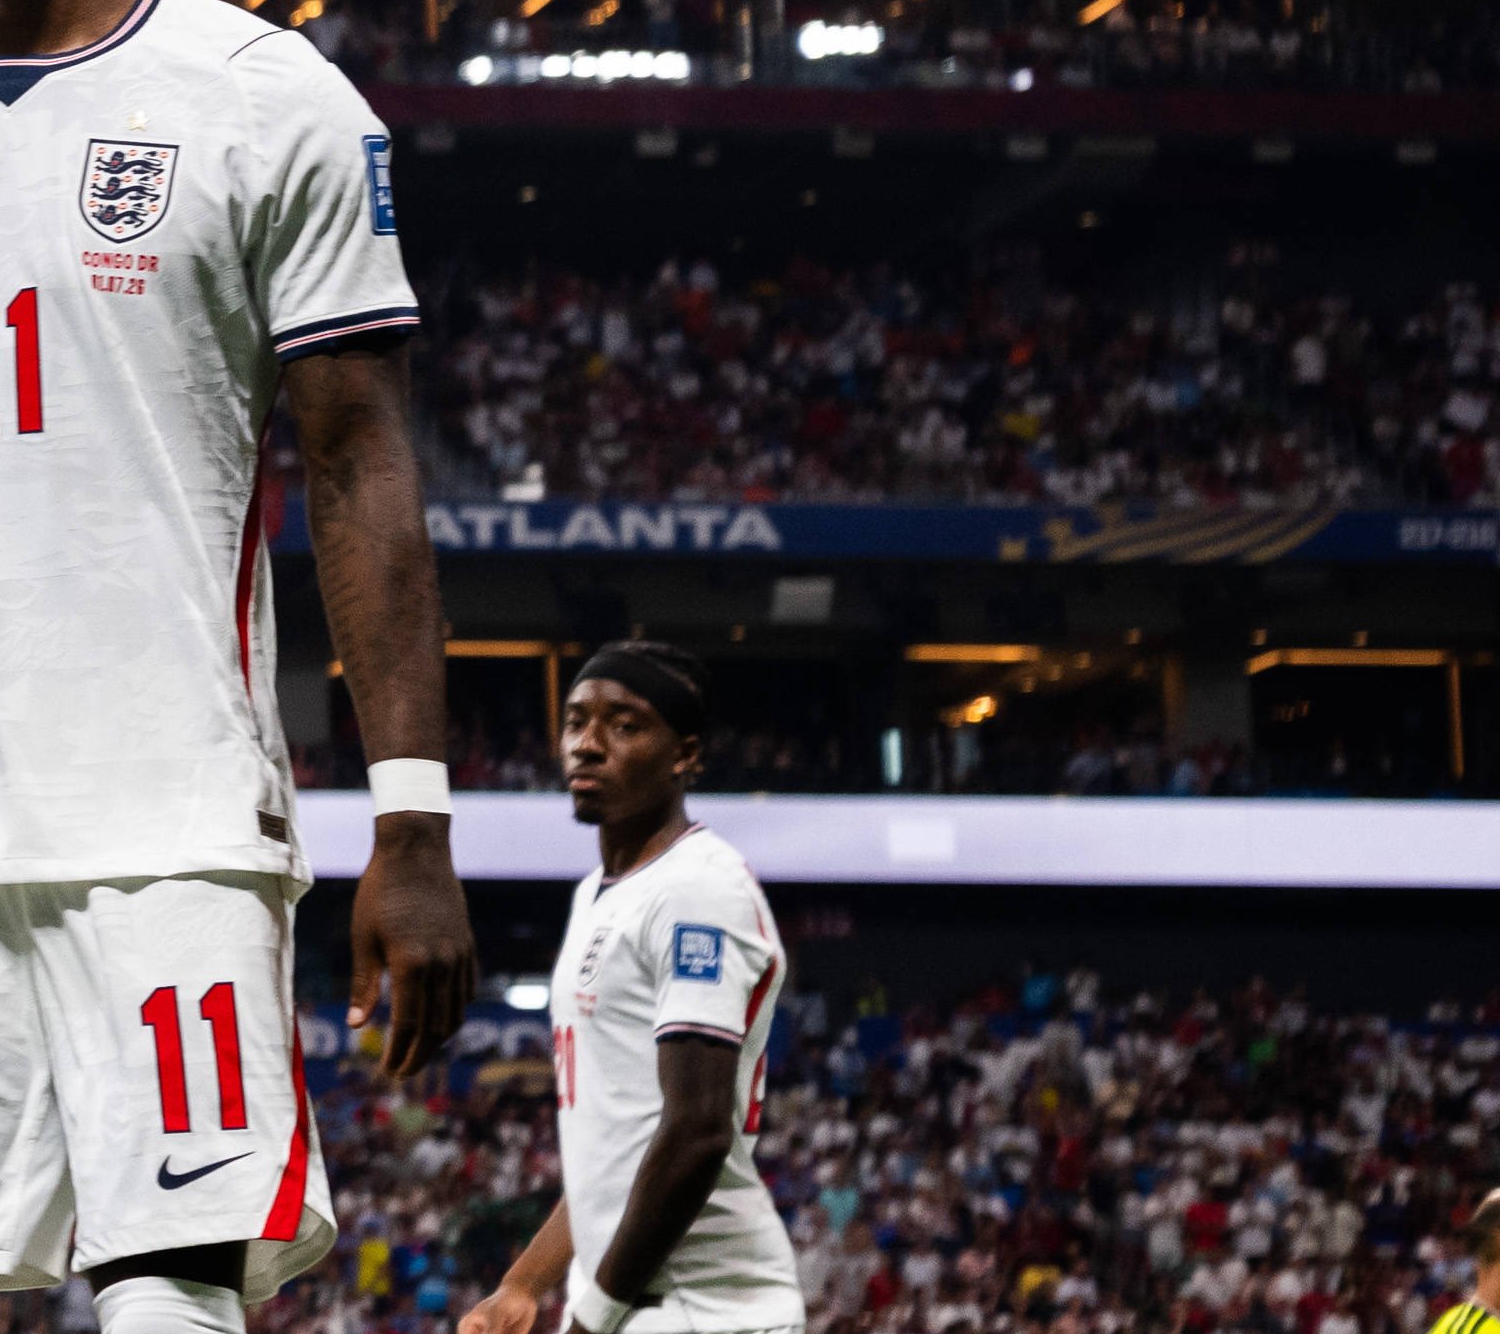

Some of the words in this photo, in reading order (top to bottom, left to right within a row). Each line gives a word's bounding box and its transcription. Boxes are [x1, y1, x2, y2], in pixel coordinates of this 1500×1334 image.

[82, 251, 132, 270] CONGO
[136, 255, 158, 272] DR
[419, 506, 785, 551] ATLANTA
[140, 981, 248, 1134] 11
